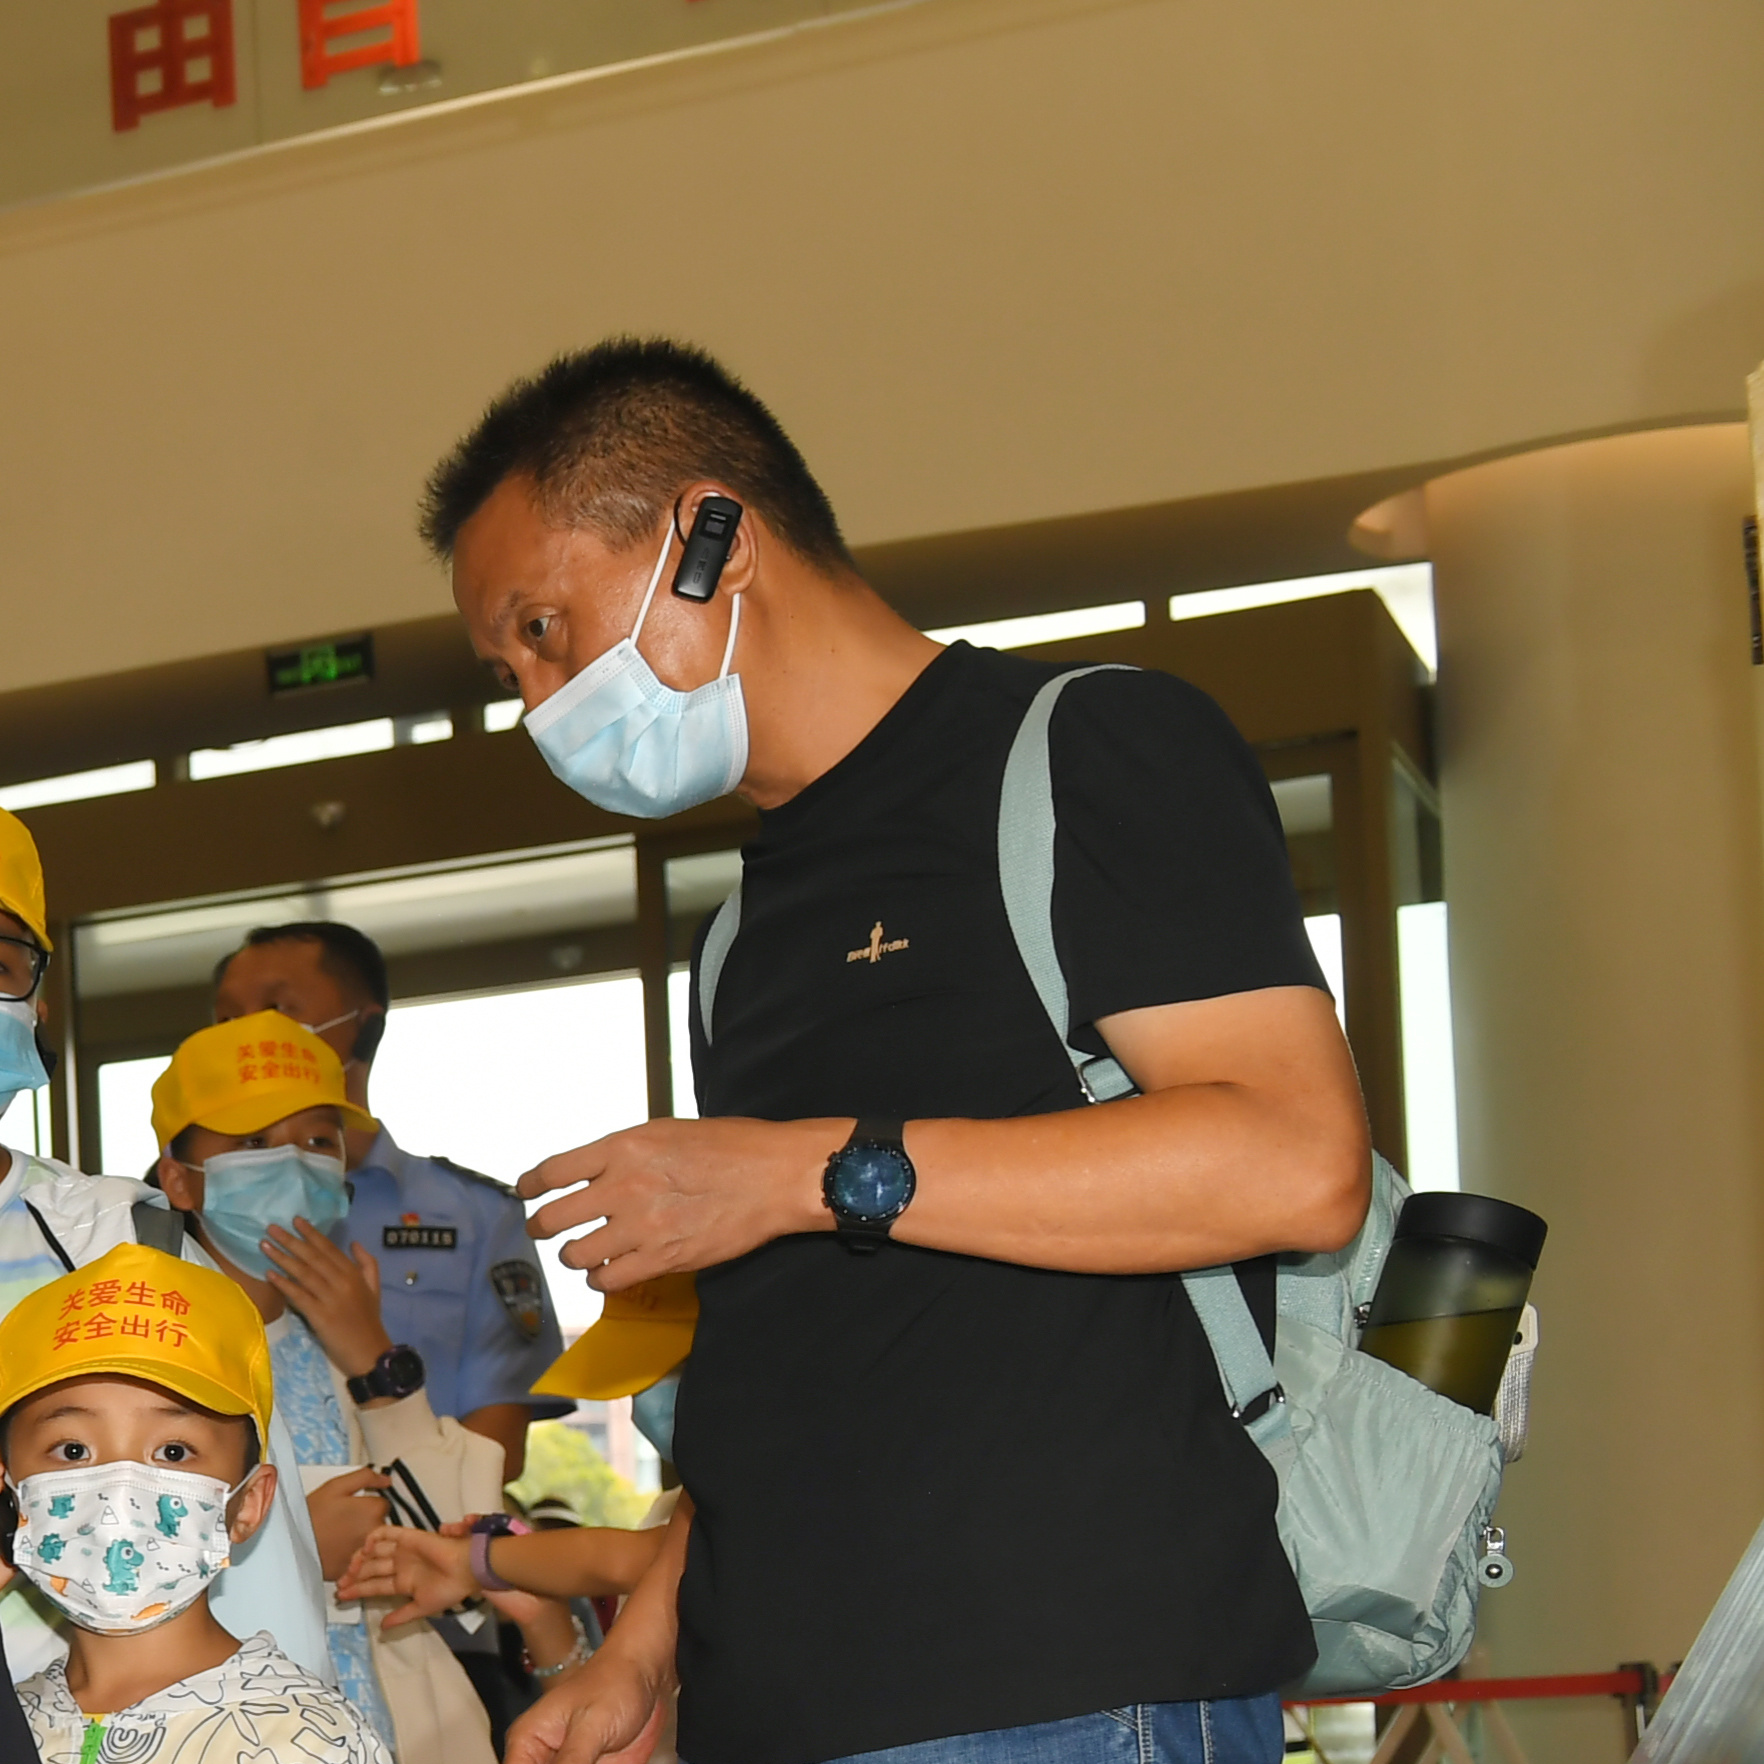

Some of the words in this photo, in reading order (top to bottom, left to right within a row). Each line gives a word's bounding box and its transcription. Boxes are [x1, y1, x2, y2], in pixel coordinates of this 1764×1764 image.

[58, 1279, 191, 1320] 关爱生命
[53, 1312, 188, 1351] 安全出行
